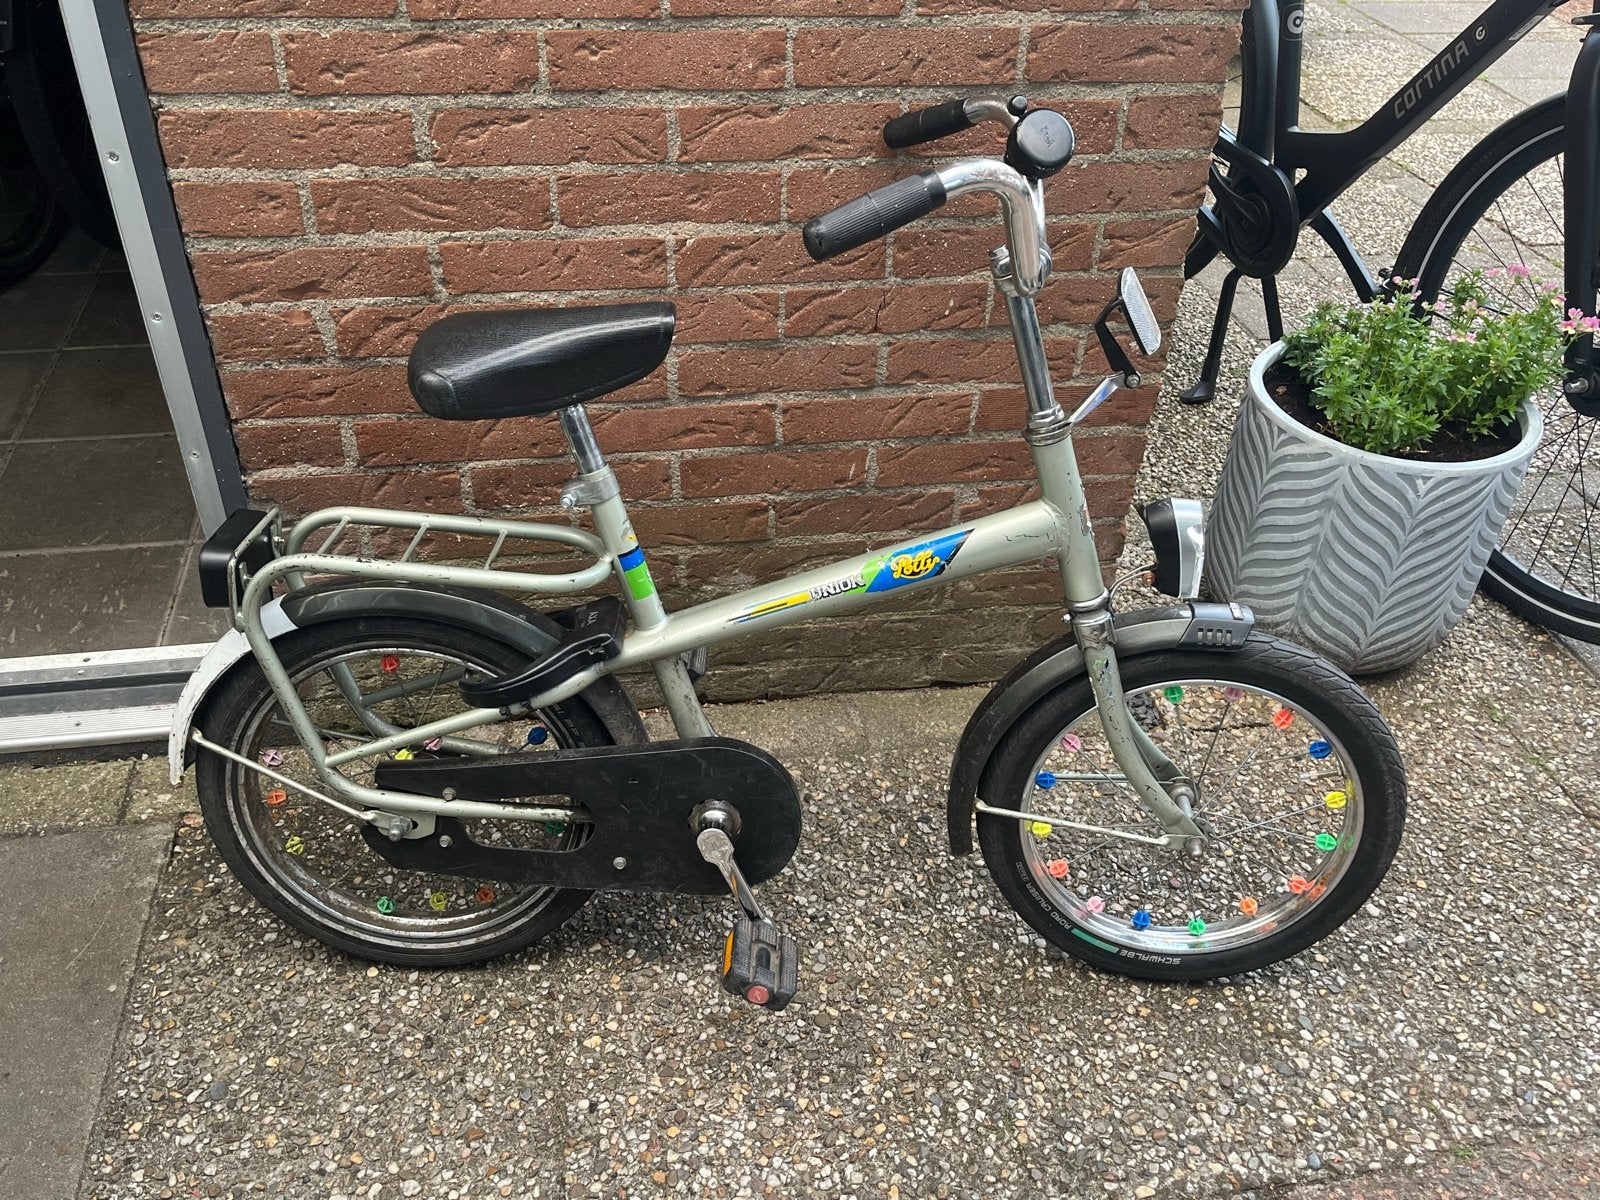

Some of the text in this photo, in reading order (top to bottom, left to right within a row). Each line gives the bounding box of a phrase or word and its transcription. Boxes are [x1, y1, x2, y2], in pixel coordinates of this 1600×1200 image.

[1394, 40, 1470, 119] CORTINA
[892, 550, 940, 579] Polly
[1026, 882, 1073, 930] ROAD CRUISER
[1119, 949, 1182, 965] SCHWALBE
